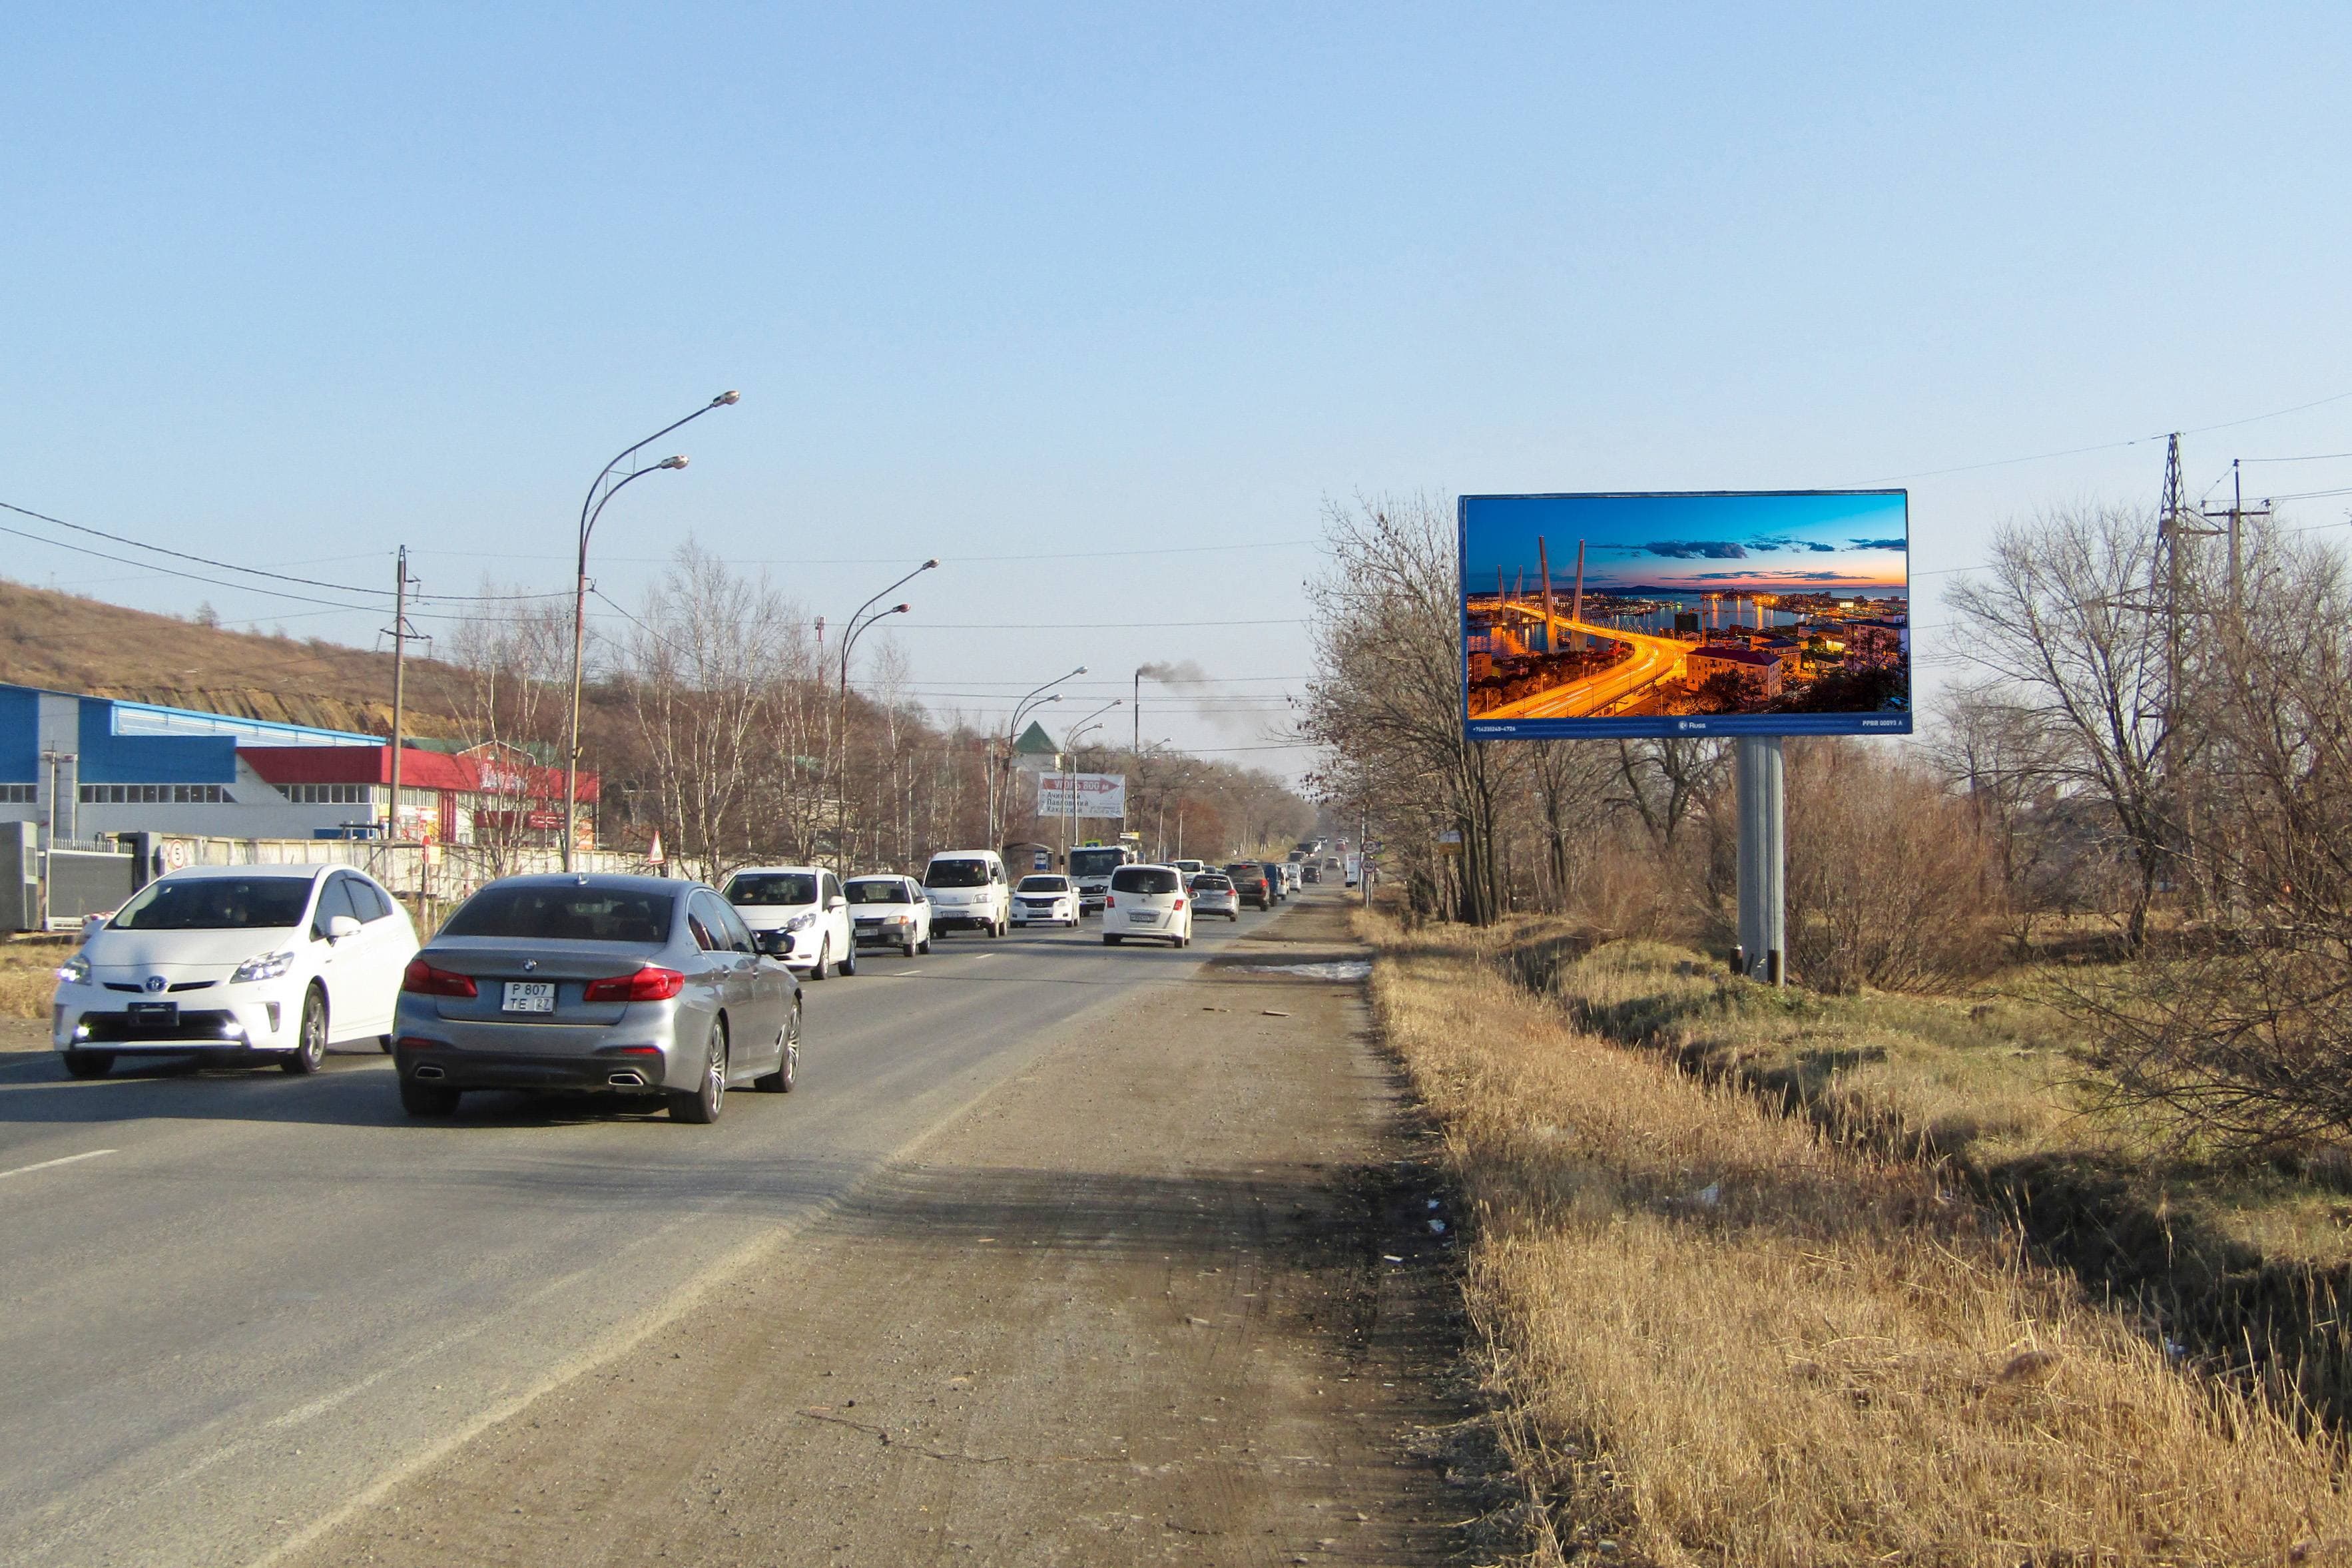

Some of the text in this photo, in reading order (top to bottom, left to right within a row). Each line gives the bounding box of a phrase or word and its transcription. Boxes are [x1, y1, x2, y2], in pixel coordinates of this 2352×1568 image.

[1083, 781, 1099, 790] 800
[175, 848, 180, 860] 5
[525, 985, 547, 995] 807
